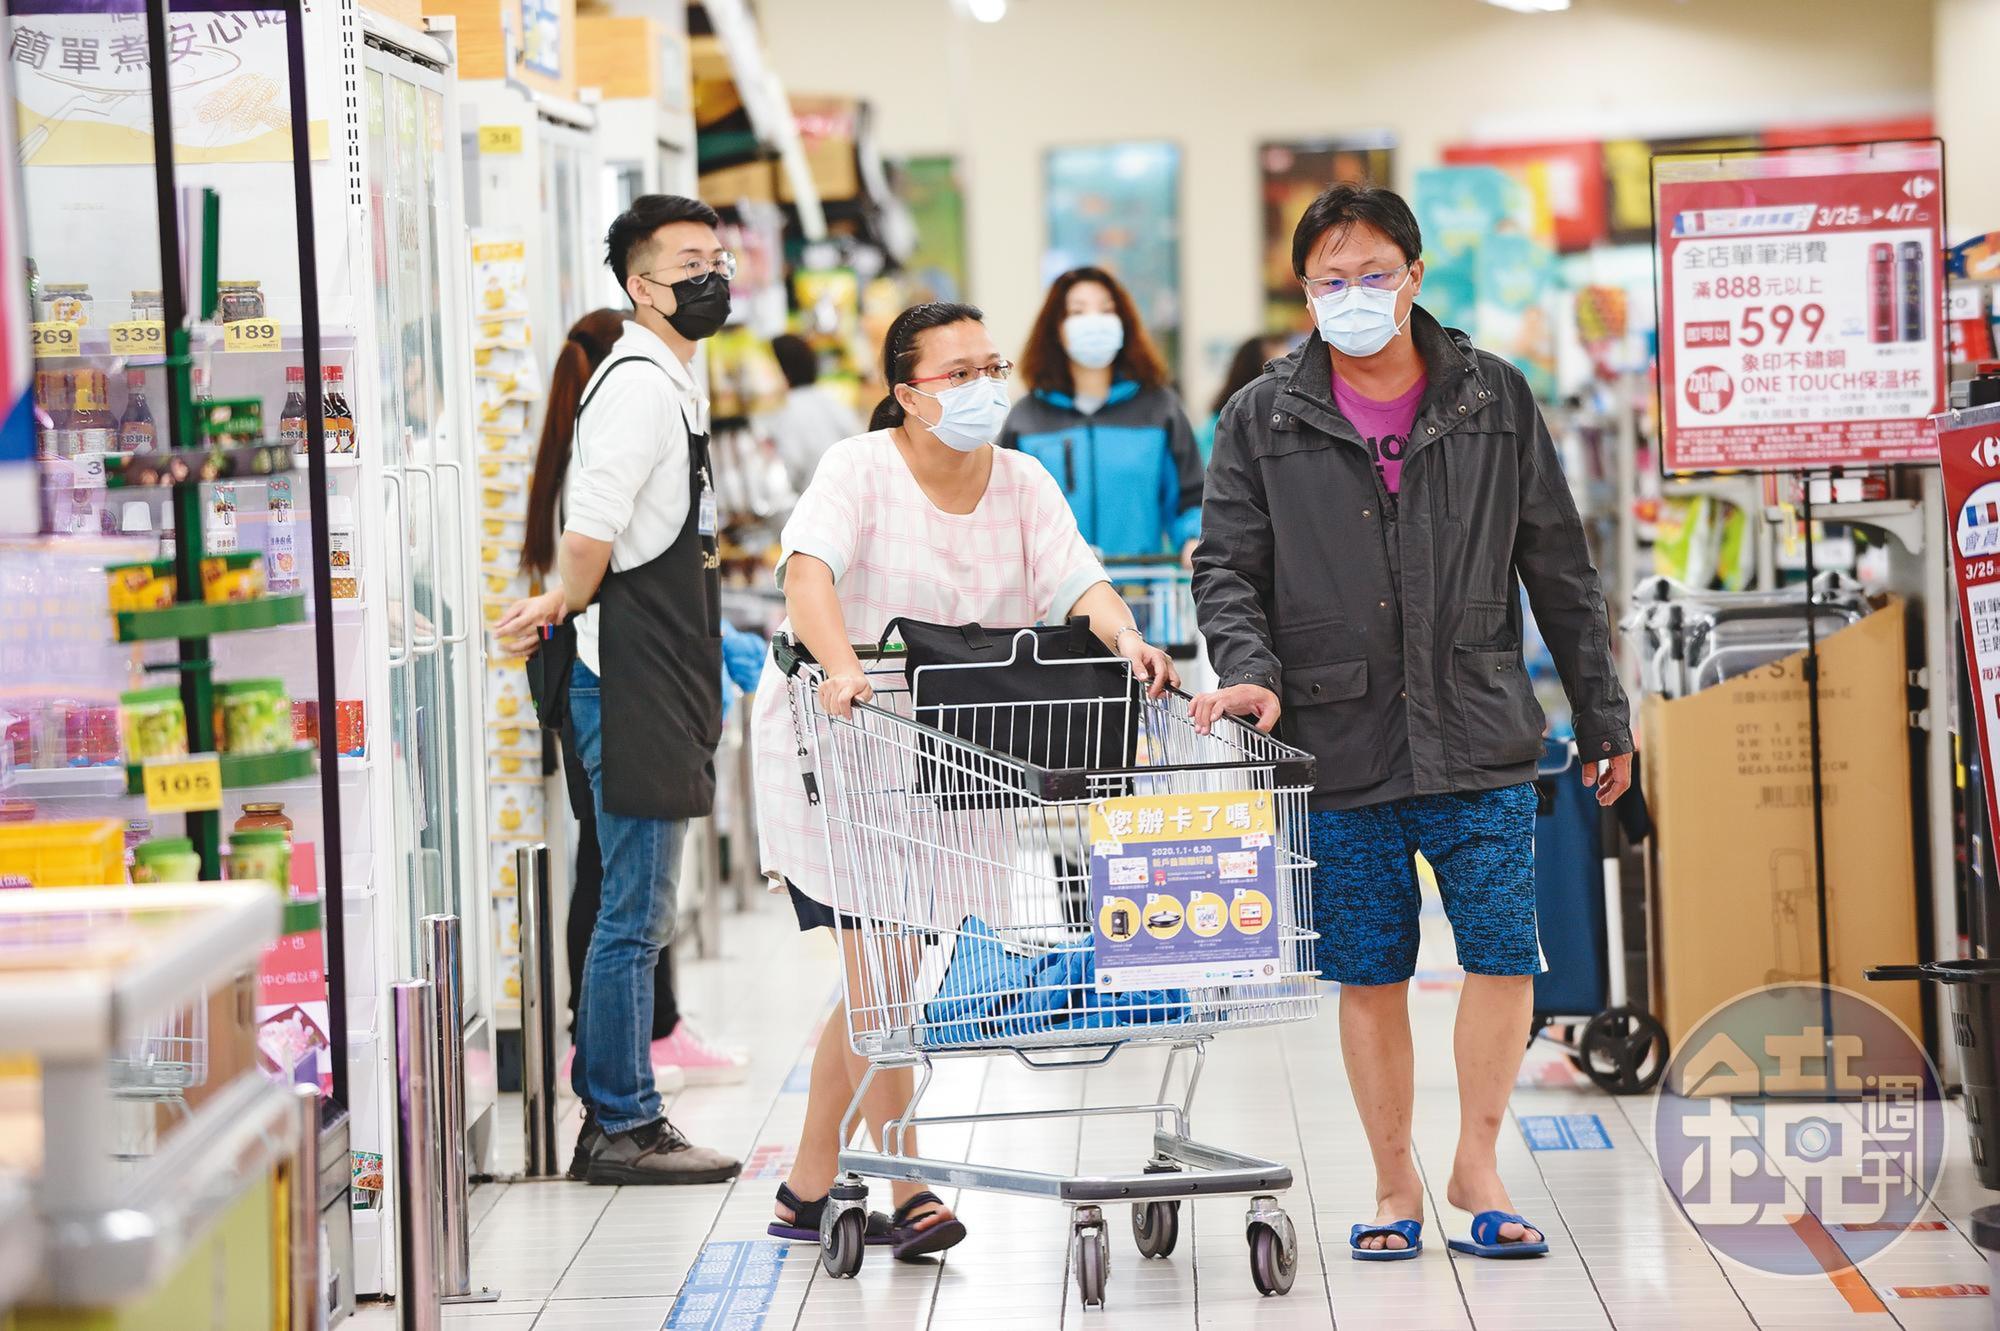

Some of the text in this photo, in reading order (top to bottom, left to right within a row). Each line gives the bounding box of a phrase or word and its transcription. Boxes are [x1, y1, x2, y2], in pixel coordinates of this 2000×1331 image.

[1817, 207, 1860, 227] 3/25
[1885, 203, 1917, 222] 4/7
[1683, 240, 1828, 270] 全店單筆消費
[1692, 275, 1823, 300] 滿888元以上
[116, 327, 161, 342] 339
[230, 324, 275, 339] 189
[1738, 303, 1826, 347] 599
[32, 329, 73, 345] 269
[1741, 349, 1847, 372] 象印不鏽鋼
[1741, 368, 1922, 394] ONE TOUCH保溫杯
[1965, 560, 1995, 580] 3/25
[156, 772, 212, 795] 105
